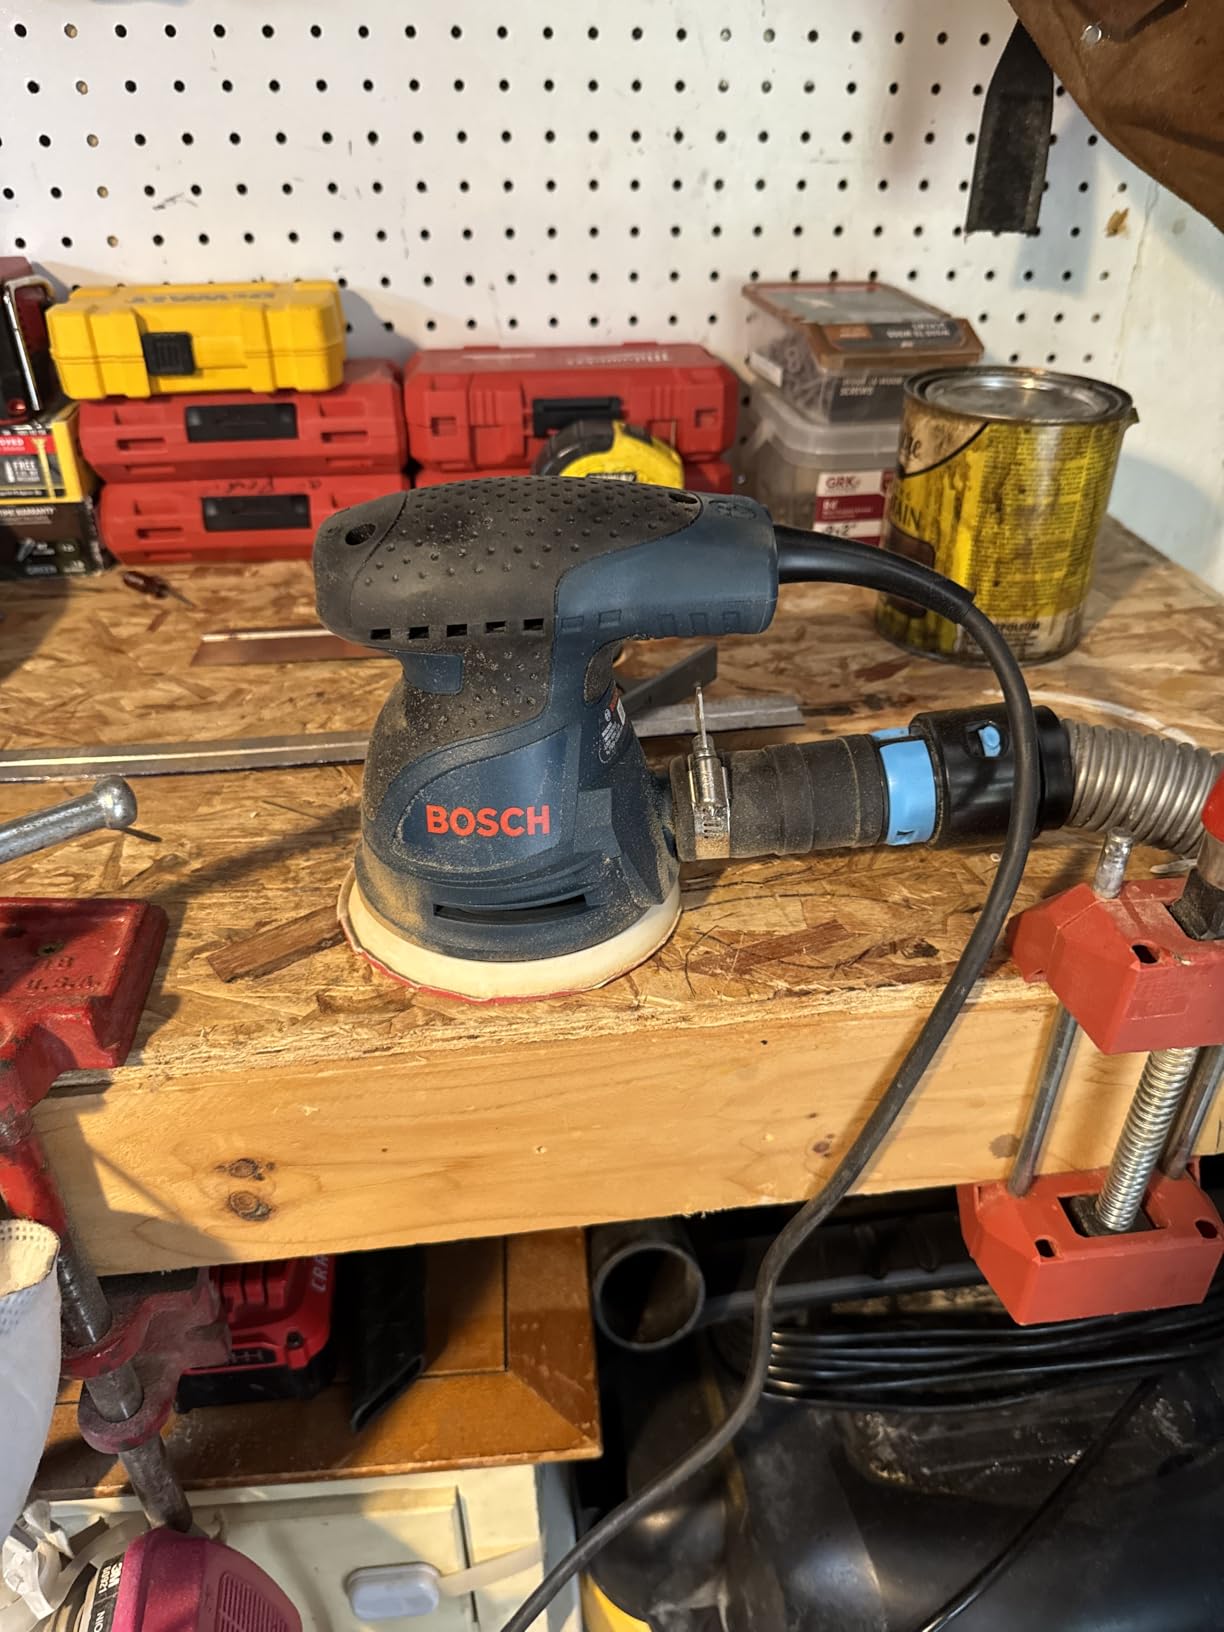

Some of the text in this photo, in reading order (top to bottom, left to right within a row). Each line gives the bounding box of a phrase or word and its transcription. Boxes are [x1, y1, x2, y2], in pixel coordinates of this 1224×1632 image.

[12, 460, 36, 471] FREE
[825, 476, 856, 490] GRK
[16, 504, 56, 517] WARRANTY
[426, 804, 550, 837] BOSCH
[108, 1562, 123, 1589] 3M
